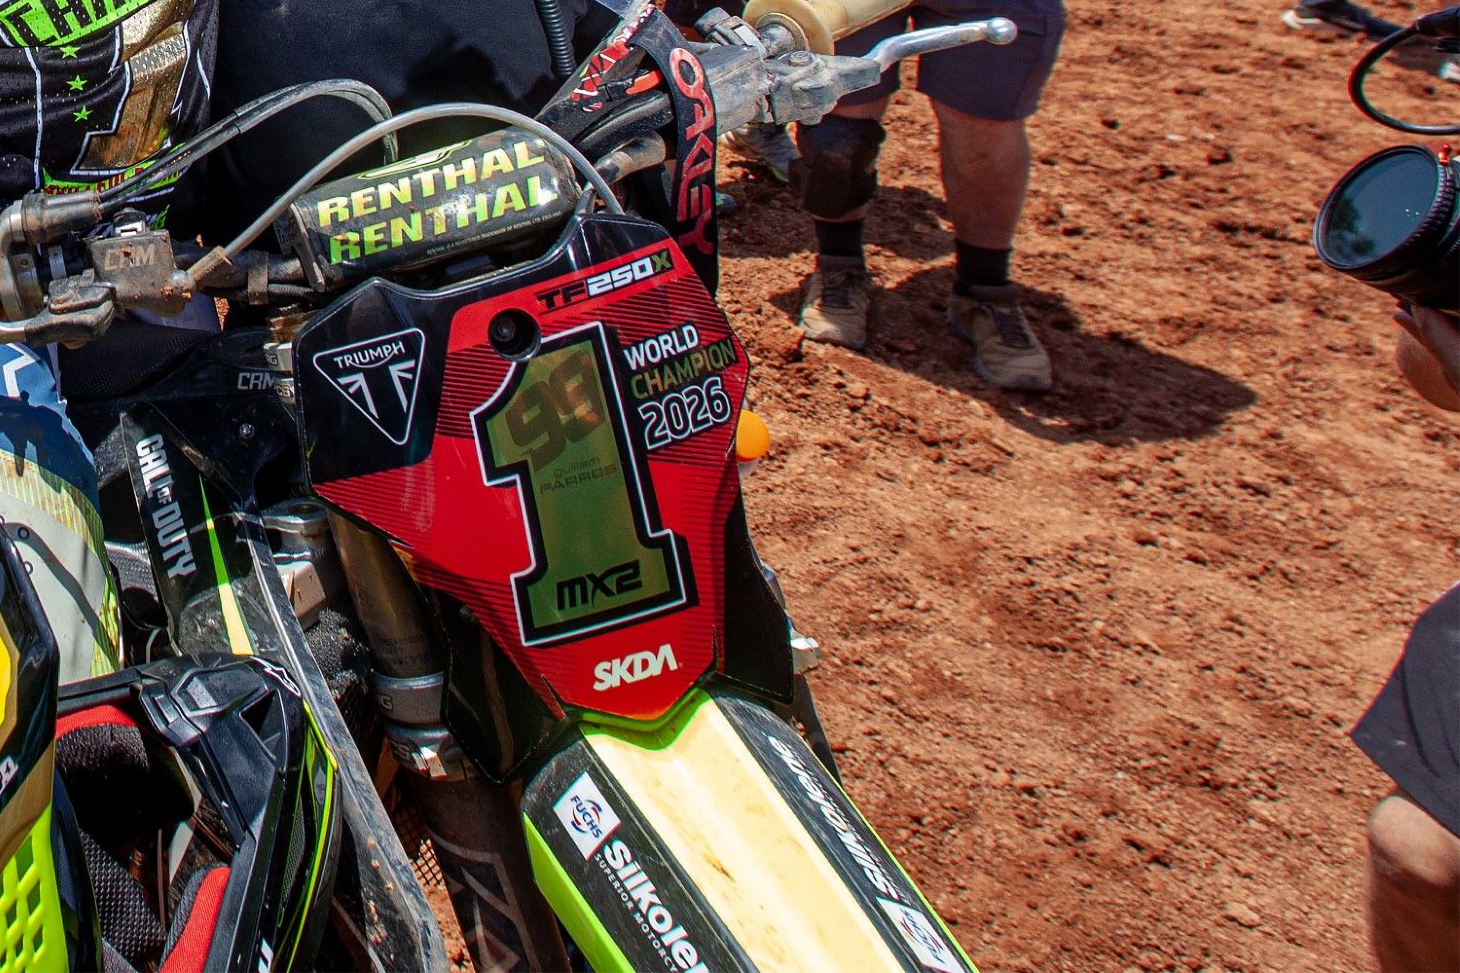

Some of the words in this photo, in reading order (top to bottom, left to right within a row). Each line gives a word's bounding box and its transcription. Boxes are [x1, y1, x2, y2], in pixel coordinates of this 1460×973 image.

[316, 140, 545, 228] RENTHAL
[329, 175, 558, 266] RENTHAL
[540, 250, 673, 310] TF250X
[334, 340, 406, 369] TRIUMPH
[623, 325, 699, 371] WORLD
[630, 338, 738, 400] CHAMPION
[638, 376, 732, 451] 2026
[135, 433, 175, 499] CALL
[156, 485, 174, 506] OF
[151, 500, 197, 579] DUTY
[556, 559, 643, 612] MX2
[593, 644, 679, 692] SKDA
[569, 793, 603, 841] FUCHS
[767, 735, 900, 901] Silkolene
[594, 853, 636, 912] SUPERIOR
